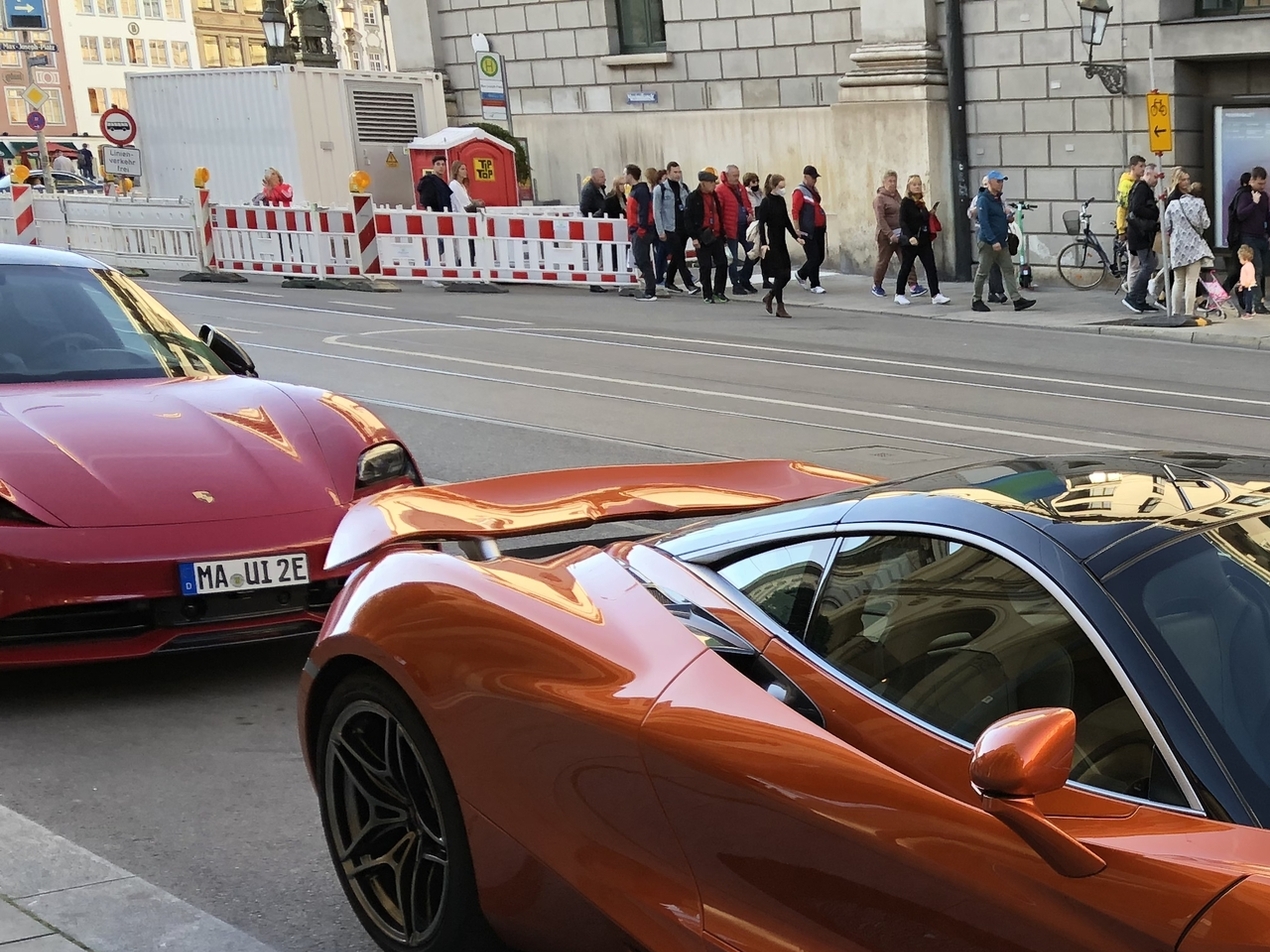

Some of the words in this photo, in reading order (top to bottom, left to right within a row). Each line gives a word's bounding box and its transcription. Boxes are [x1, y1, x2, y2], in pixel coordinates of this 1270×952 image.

[485, 60, 493, 72] H
[186, 582, 192, 590] D
[197, 564, 229, 590] MA
[244, 560, 273, 585] UI
[276, 557, 307, 582] 2E
